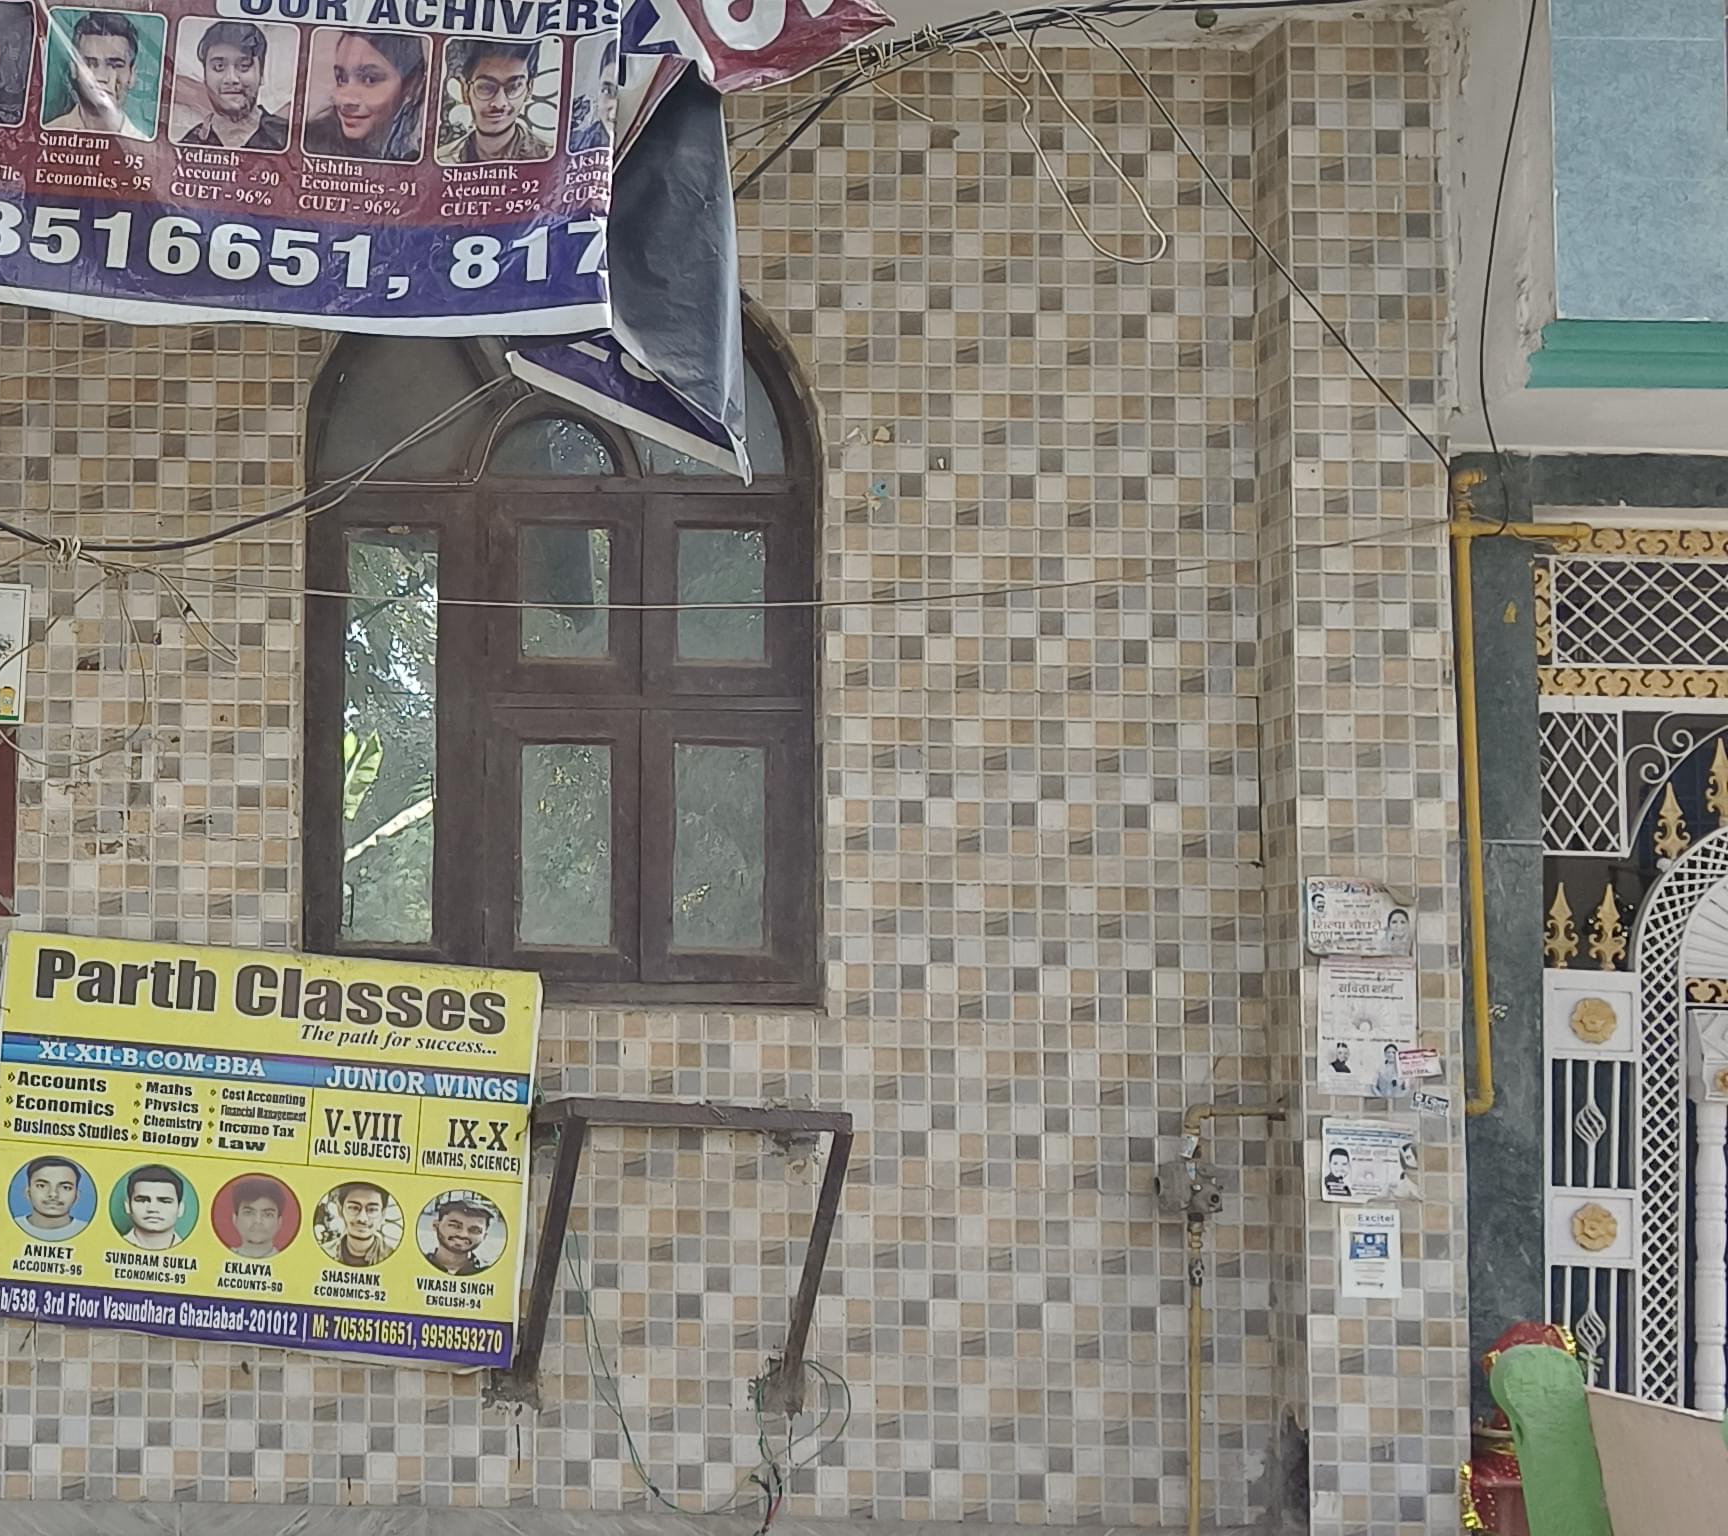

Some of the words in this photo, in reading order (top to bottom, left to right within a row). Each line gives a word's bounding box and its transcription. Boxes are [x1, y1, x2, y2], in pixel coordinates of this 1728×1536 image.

[38, 131, 110, 150] Sundram
[37, 148, 101, 167] Account
[172, 164, 238, 184] Account
[300, 158, 364, 178] Nishtha
[442, 165, 519, 183] Shashank
[34, 168, 118, 190] Economics
[300, 174, 386, 197] Economics
[170, 181, 224, 202] CUET
[297, 194, 351, 215] CUET
[439, 201, 493, 219] CUET
[449, 219, 607, 291] 817
[34, 947, 218, 1013] Parth
[234, 964, 508, 1036] Classes
[300, 1023, 335, 1044] The
[338, 1026, 379, 1049] path
[378, 1029, 413, 1051] for
[415, 1036, 498, 1056] success...
[37, 1039, 266, 1077] XI-XII-B.COM-BBA
[16, 1070, 108, 1093] Accounts
[145, 1081, 193, 1098] Maths
[325, 1065, 426, 1095] JUNIOR
[433, 1072, 519, 1102] WINGS
[222, 1088, 245, 1101] Cost
[15, 1094, 115, 1117] Economics
[144, 1097, 200, 1115] Physics
[13, 1117, 76, 1138] Business
[77, 1121, 130, 1143] Studies
[143, 1113, 203, 1132] Chemistry
[219, 1120, 271, 1136] Income
[272, 1124, 296, 1139] Tax
[324, 1107, 404, 1143] V-VIII
[141, 1131, 200, 1148] Biology
[217, 1137, 267, 1152] Law
[447, 1117, 510, 1153] IX-X
[314, 1138, 341, 1157] (ALL
[343, 1140, 412, 1165] SUBJECTS)
[421, 1149, 468, 1171] (MATHS,
[469, 1152, 522, 1176] SCIENCE)
[1358, 1213, 1394, 1223] Excitel
[23, 1243, 75, 1261] ANIKET
[104, 1250, 160, 1269] SUNDRAM
[162, 1254, 198, 1271] SUKLA
[12, 1259, 84, 1276] ACCOUNTS-96
[223, 1261, 273, 1278] EKLAVYA
[320, 1269, 382, 1287] SHASHANK
[415, 1277, 459, 1294] VIKASH
[460, 1281, 495, 1297] SINGH
[312, 1285, 388, 1303] ECONOMICS-92
[425, 1294, 482, 1310] ENGLISH-94
[43, 1289, 66, 1315] 3rd
[67, 1291, 101, 1318] Floor
[103, 1294, 176, 1325] Vasundhara
[179, 1299, 298, 1337] Ghaziabad-201012
[312, 1313, 330, 1339] M:
[332, 1315, 418, 1351] 7053516651,
[421, 1323, 503, 1354] 9958593270
